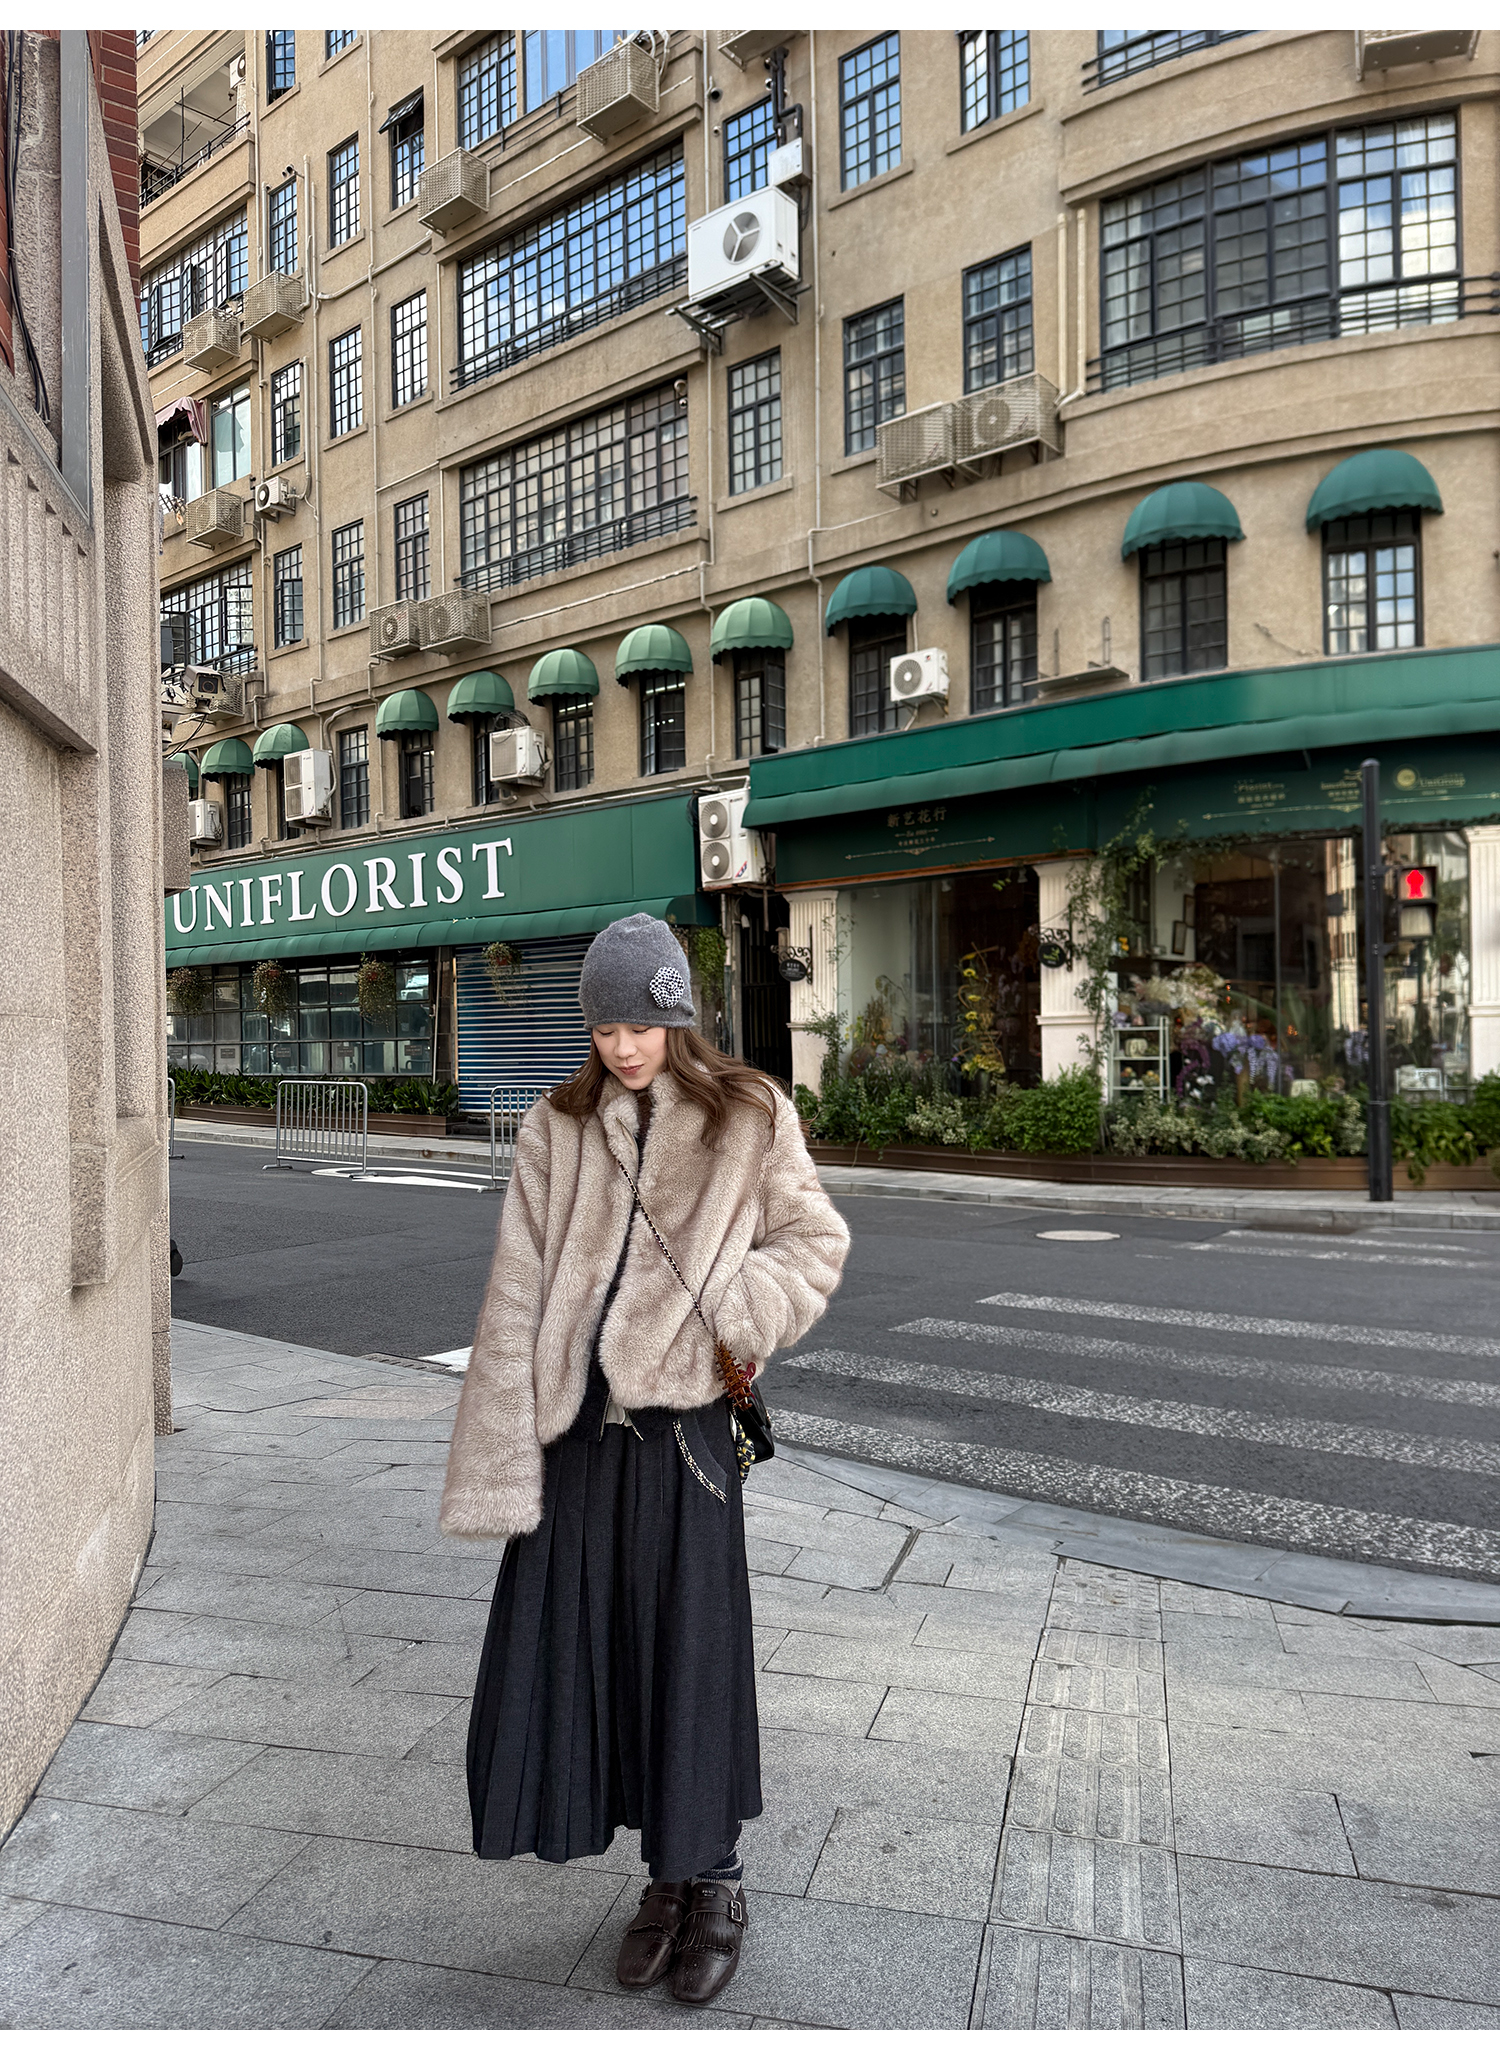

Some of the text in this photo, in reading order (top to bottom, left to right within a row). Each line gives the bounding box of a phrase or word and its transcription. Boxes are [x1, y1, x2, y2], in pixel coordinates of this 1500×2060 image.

[887, 806, 947, 828] 新艺花行
[173, 837, 513, 934] UNIFLORIST
